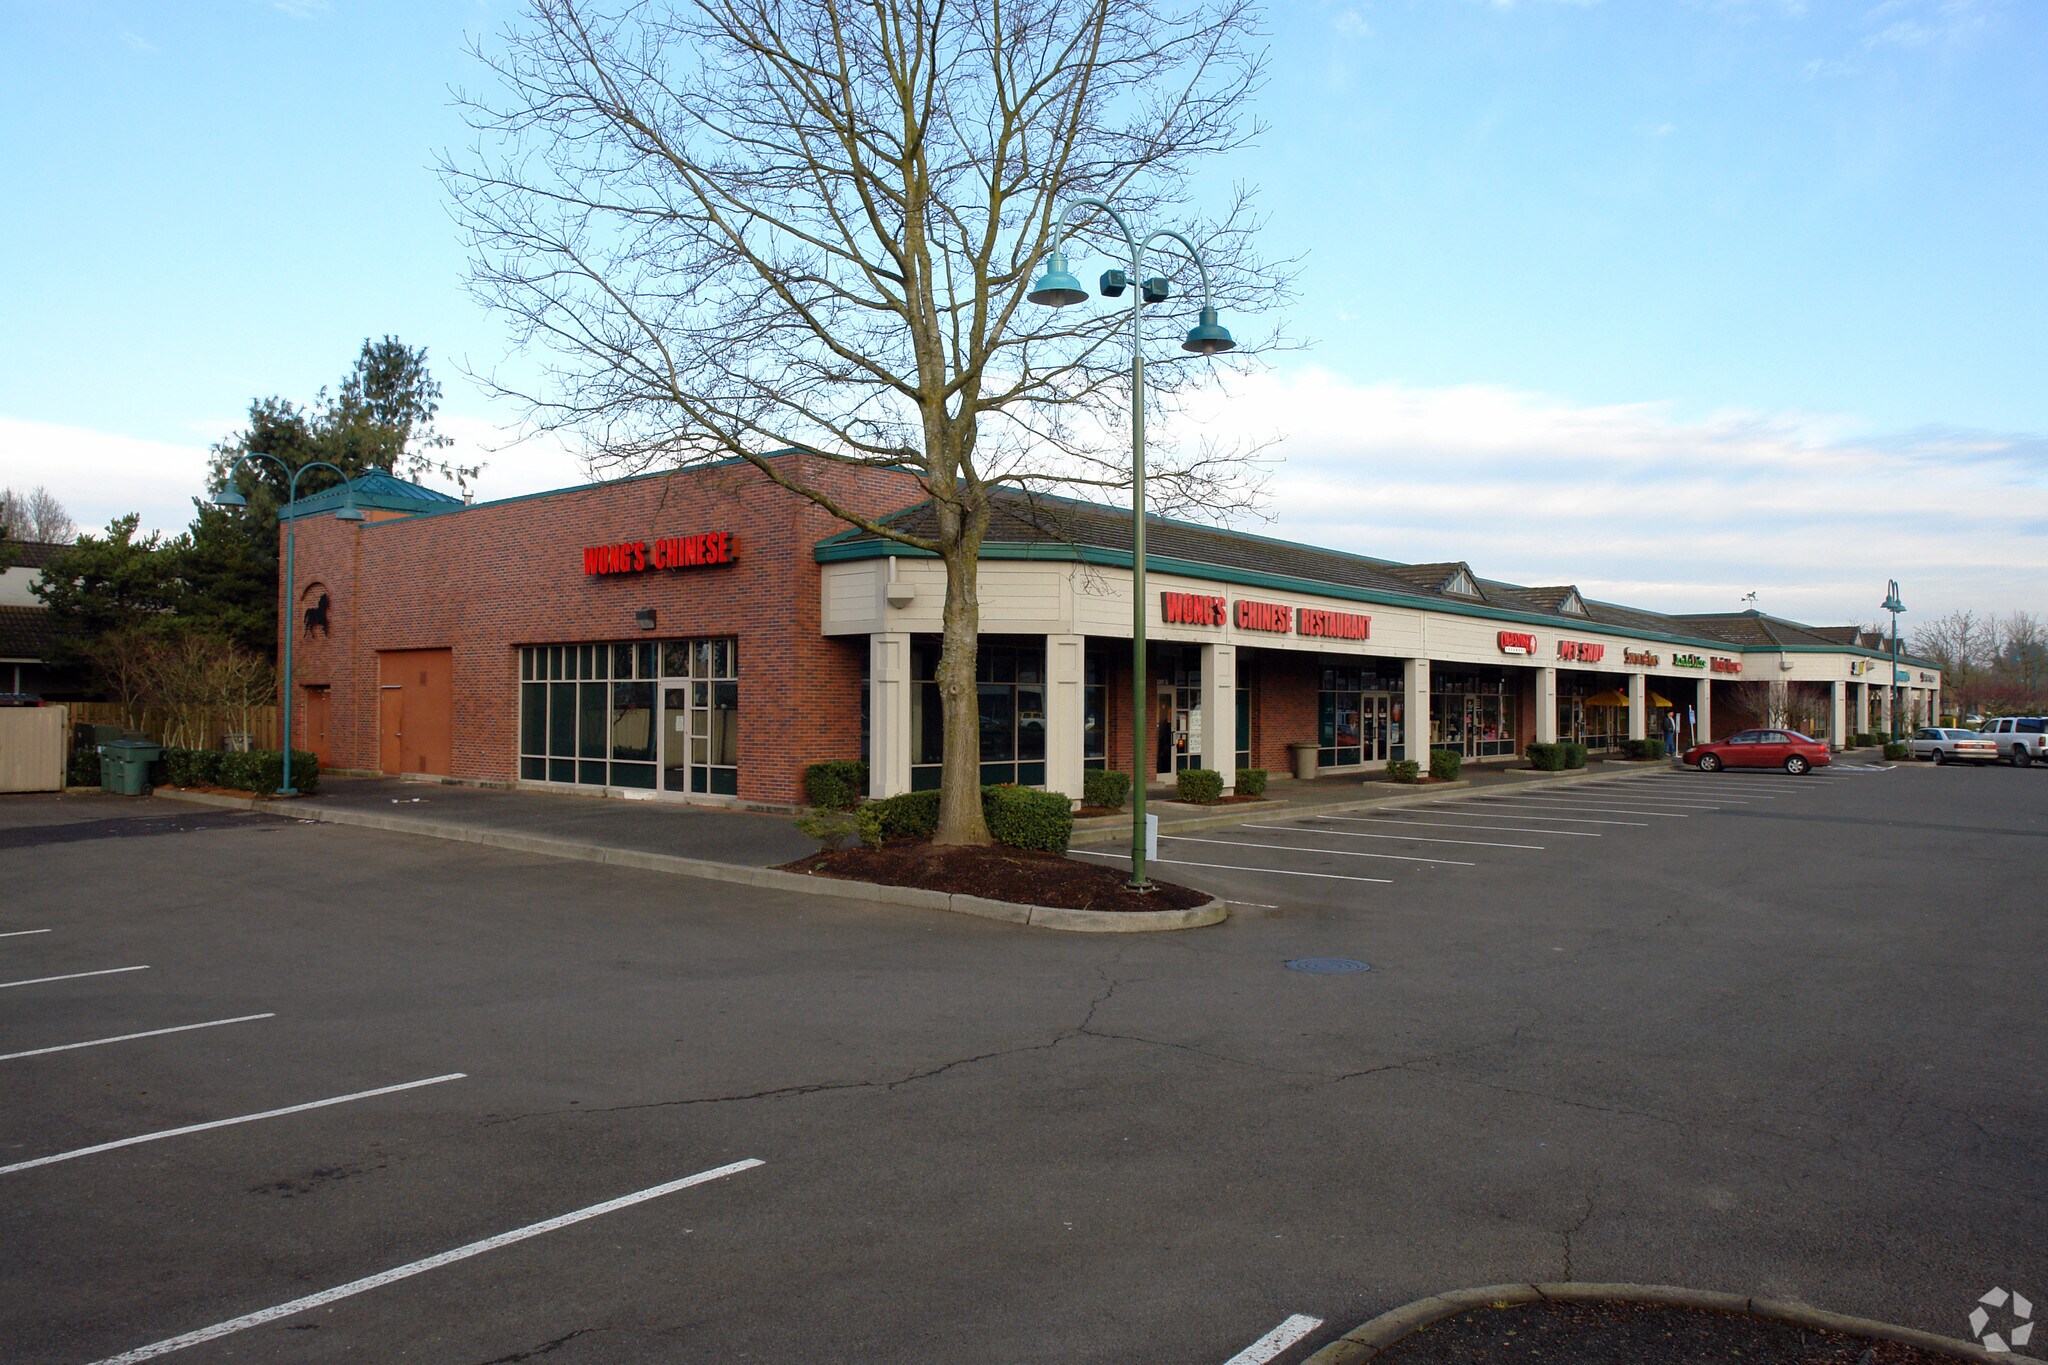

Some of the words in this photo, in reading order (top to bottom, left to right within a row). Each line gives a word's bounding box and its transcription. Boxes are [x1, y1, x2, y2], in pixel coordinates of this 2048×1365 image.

[584, 541, 645, 575] WONG'S
[655, 532, 728, 569] CHINESE
[1164, 592, 1227, 626] WONG'S
[1236, 600, 1293, 633] CHINESE
[1300, 608, 1372, 640] RESTAURANT
[1561, 641, 1579, 660] PET
